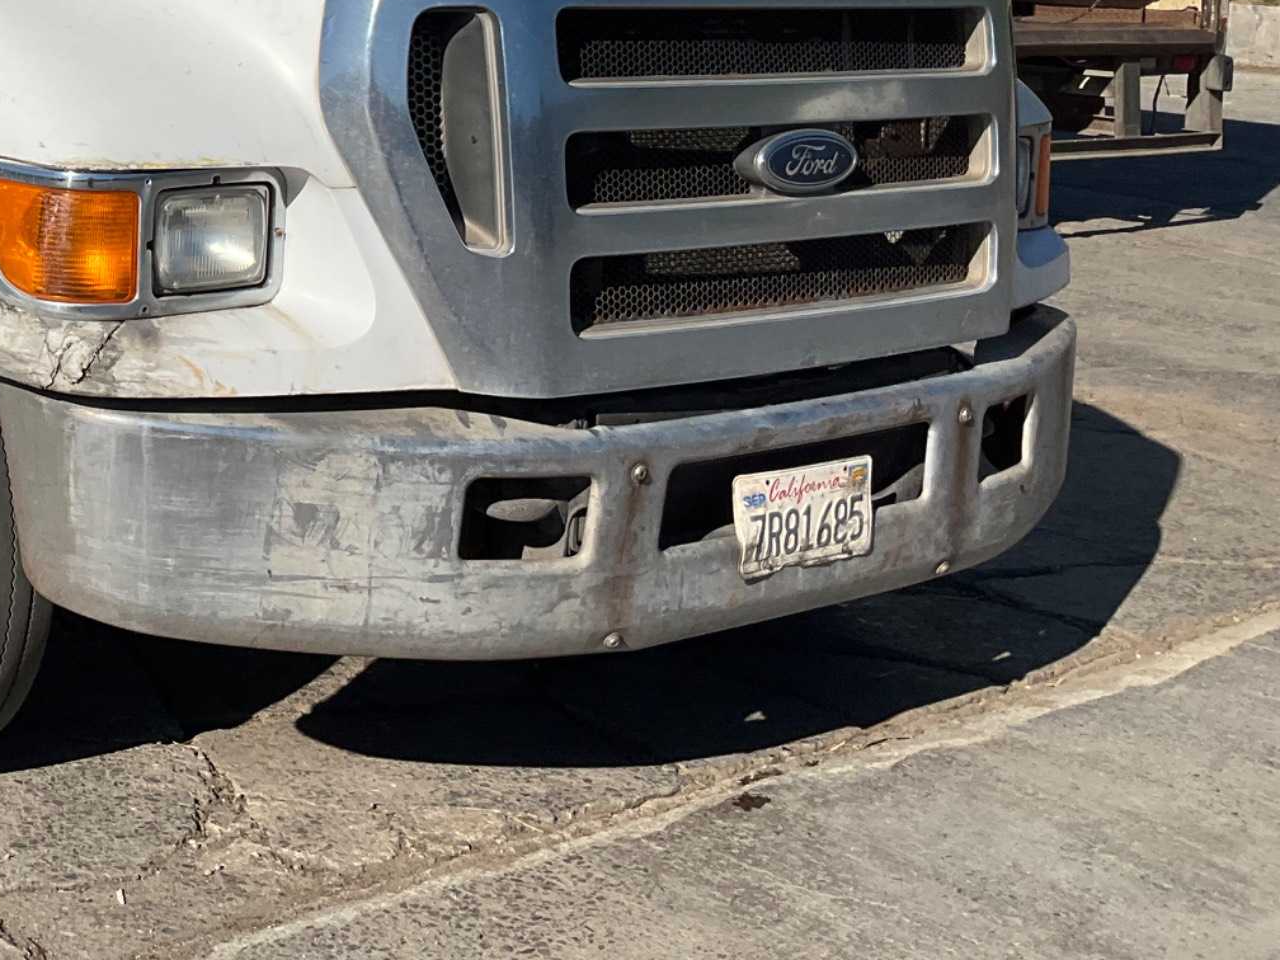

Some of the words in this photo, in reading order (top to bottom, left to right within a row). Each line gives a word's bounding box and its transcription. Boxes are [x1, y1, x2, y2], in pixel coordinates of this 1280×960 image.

[785, 144, 838, 176] Ford
[768, 474, 841, 504] California
[750, 494, 864, 561] 7R81685
